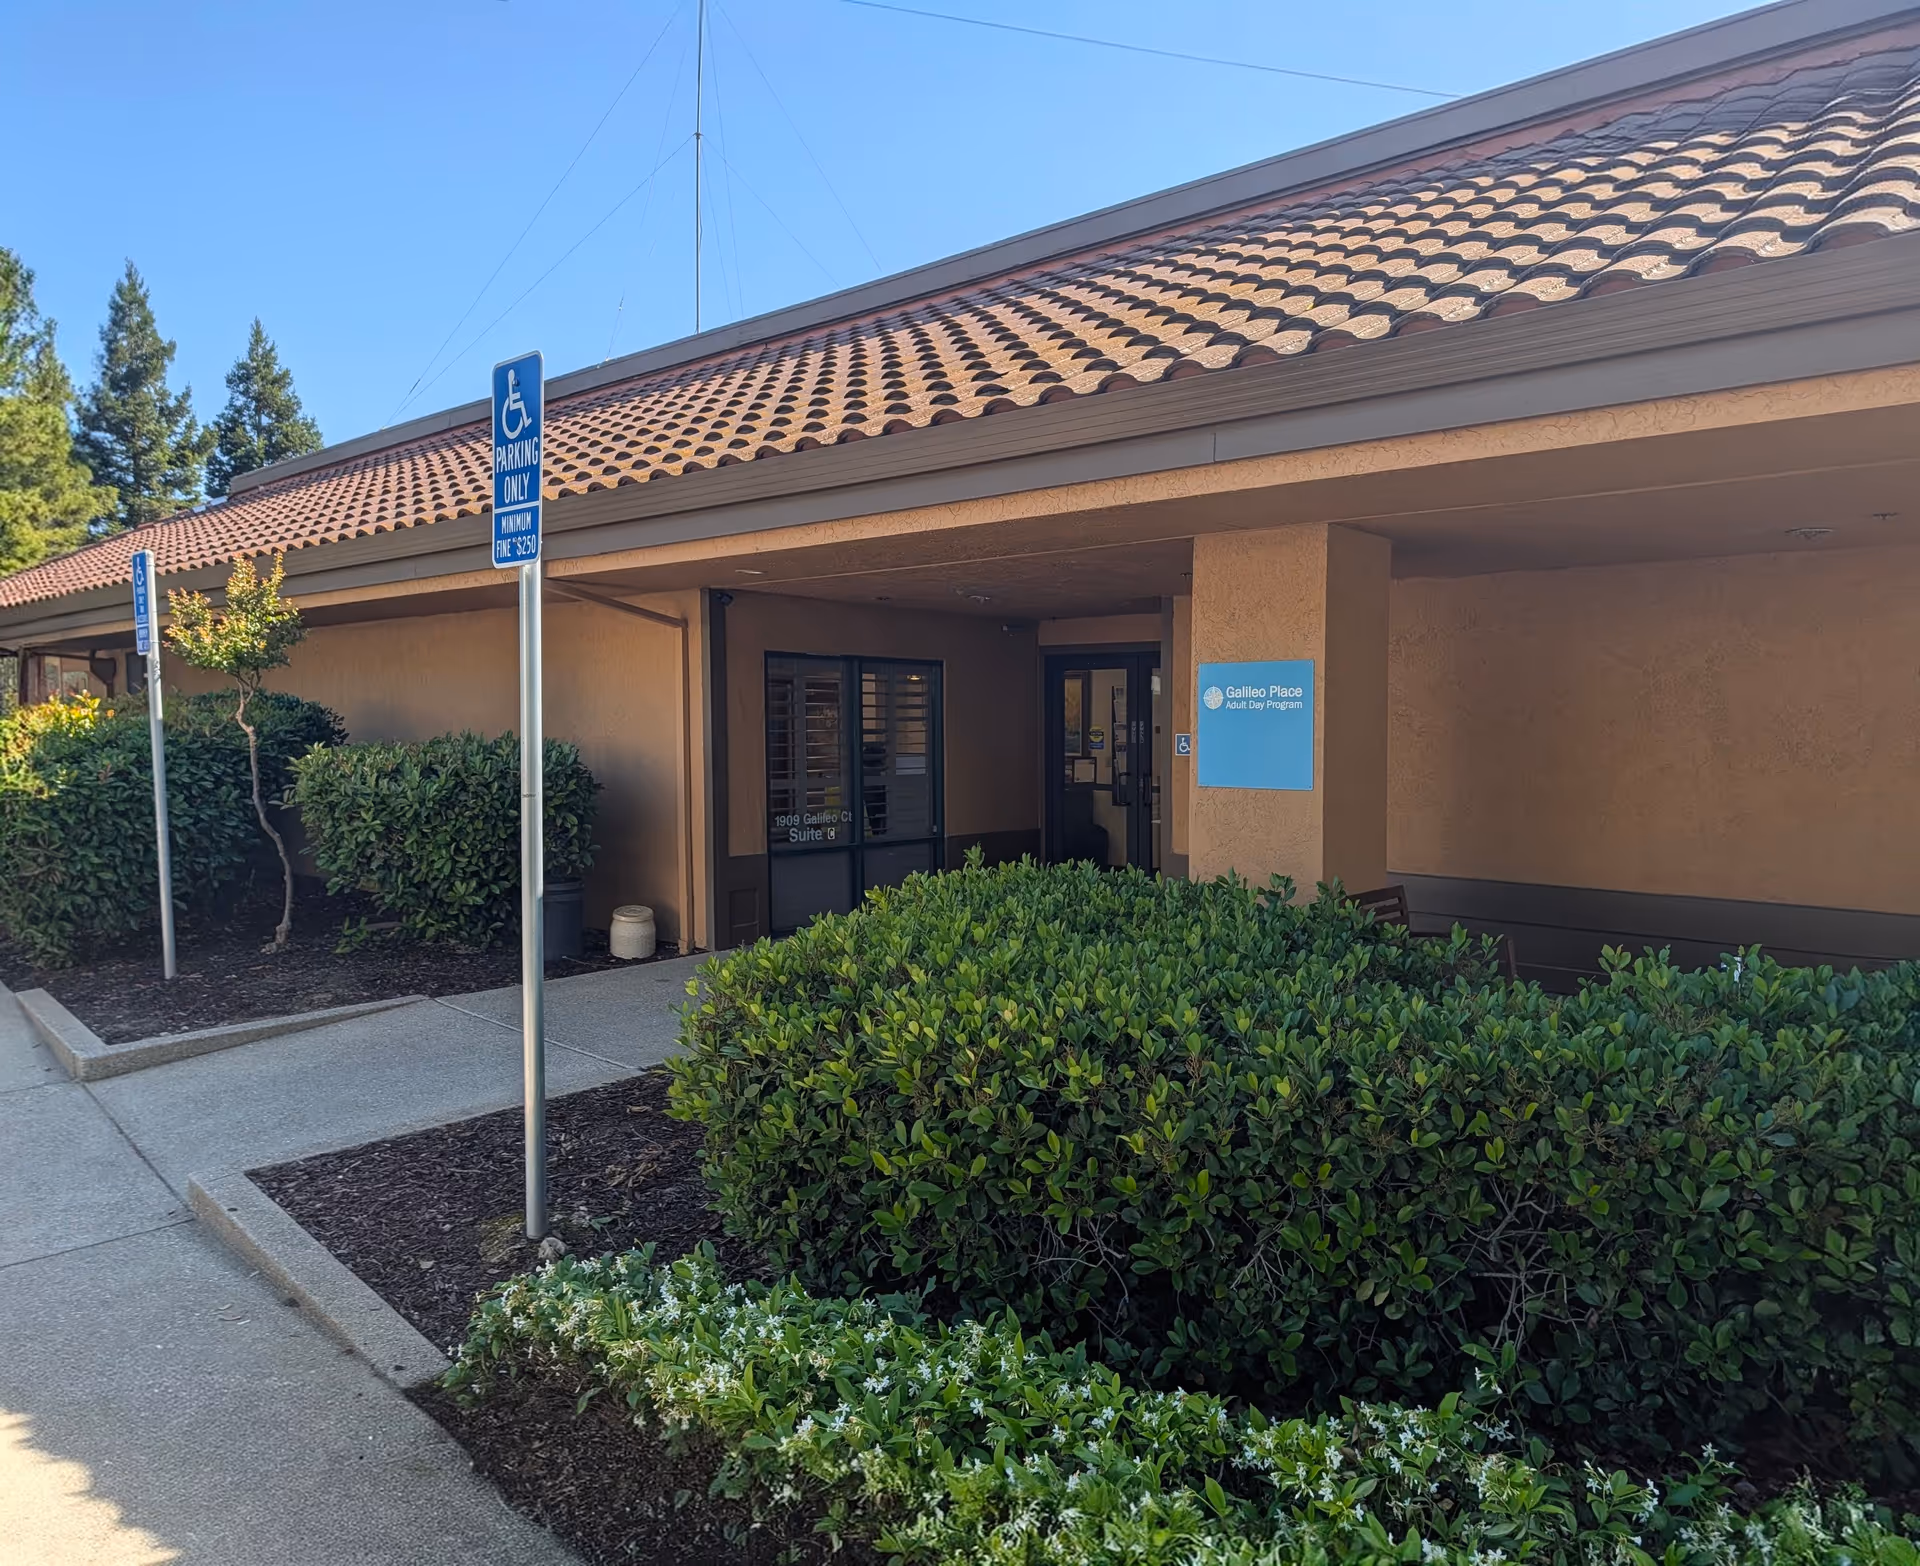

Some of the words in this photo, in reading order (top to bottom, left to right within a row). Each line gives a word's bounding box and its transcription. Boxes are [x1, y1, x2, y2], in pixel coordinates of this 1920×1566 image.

[496, 437, 539, 474] PARKING
[504, 472, 530, 504] ONLY
[501, 512, 531, 534] MINIMUM
[496, 539, 512, 558] FINE
[516, 534, 536, 556] $250
[1226, 686, 1266, 698] Galileo
[1269, 685, 1303, 698] Place
[1225, 700, 1247, 709] Adult
[1249, 700, 1265, 711] Day
[1266, 700, 1303, 711] Program
[774, 815, 800, 827] 1909
[803, 812, 837, 825] Galileo
[840, 811, 853, 823] Ct
[789, 827, 823, 843] Suite
